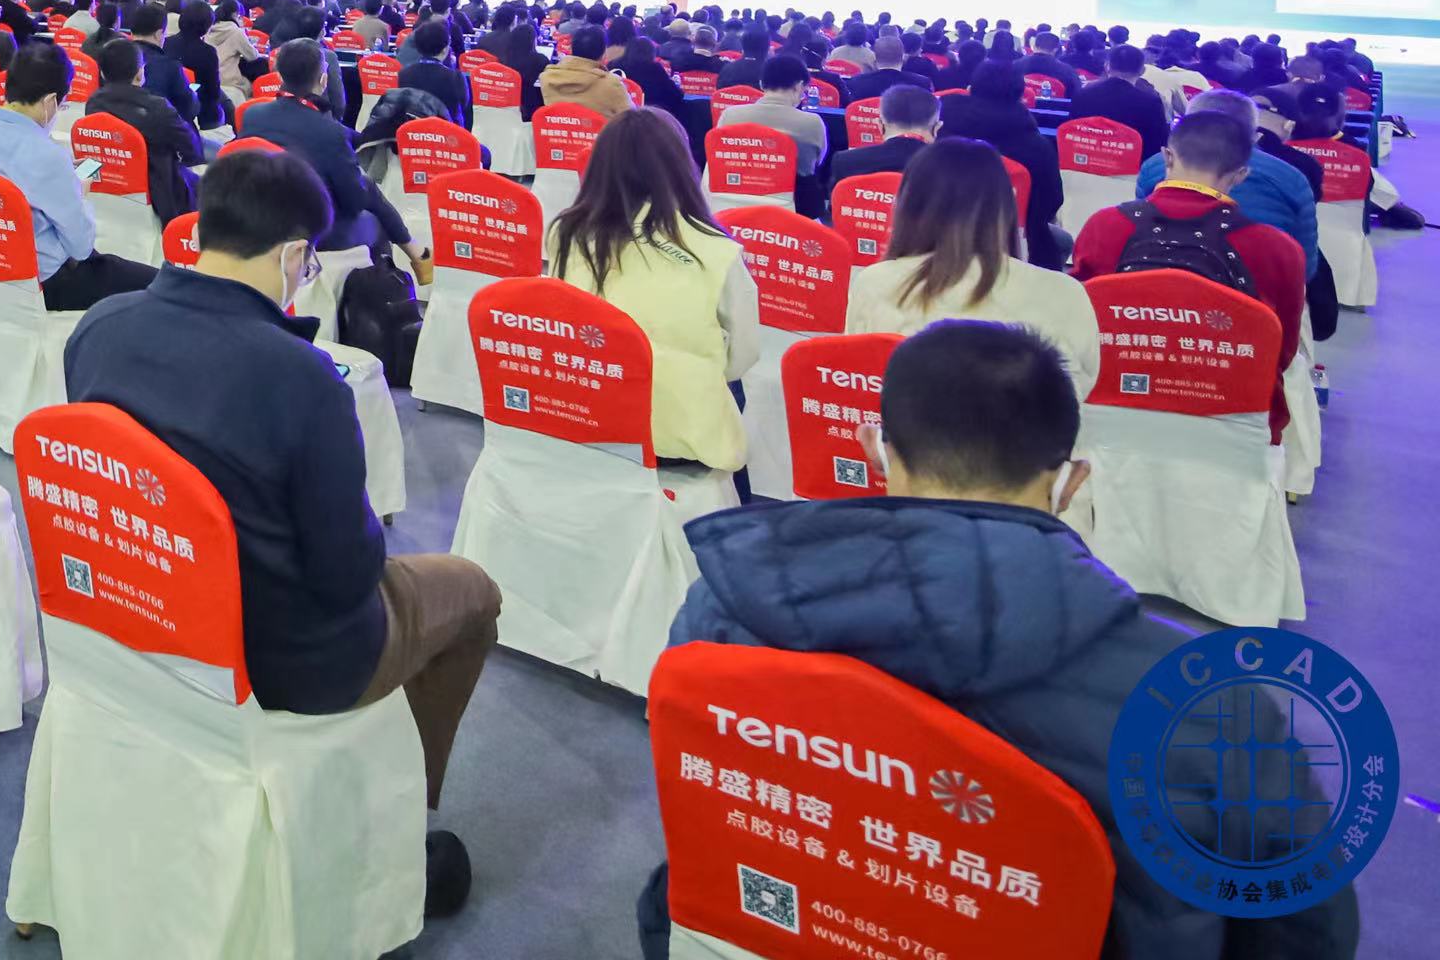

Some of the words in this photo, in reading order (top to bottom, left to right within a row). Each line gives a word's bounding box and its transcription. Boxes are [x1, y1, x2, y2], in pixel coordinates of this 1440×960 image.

[77, 128, 111, 140] Tensun
[407, 132, 445, 143] Tensun
[721, 137, 762, 147] Tensun
[448, 189, 499, 209] Tensun
[855, 188, 892, 204] Tens
[730, 225, 800, 250] Tensun
[489, 309, 575, 339] Tensun
[1109, 305, 1201, 324] Tensun
[1178, 336, 1255, 358] 世界品质
[552, 351, 623, 380] 世界品质
[816, 366, 883, 393] Tens
[35, 435, 131, 488] Tensun
[27, 475, 99, 520] 腾盛精密
[110, 506, 195, 562] 世界品质
[53, 515, 99, 542] 点胶设备
[104, 533, 113, 546] &
[117, 537, 172, 574] 划片设备
[97, 572, 164, 609] 400-885-0766
[98, 589, 176, 632] www.tensun.cn
[707, 704, 917, 796] Tensun
[680, 752, 833, 829] 腾盛精密
[859, 815, 1043, 907] 世界品质
[726, 809, 827, 860] 点胶设备
[836, 850, 856, 870] &
[865, 858, 981, 919] 划片设备
